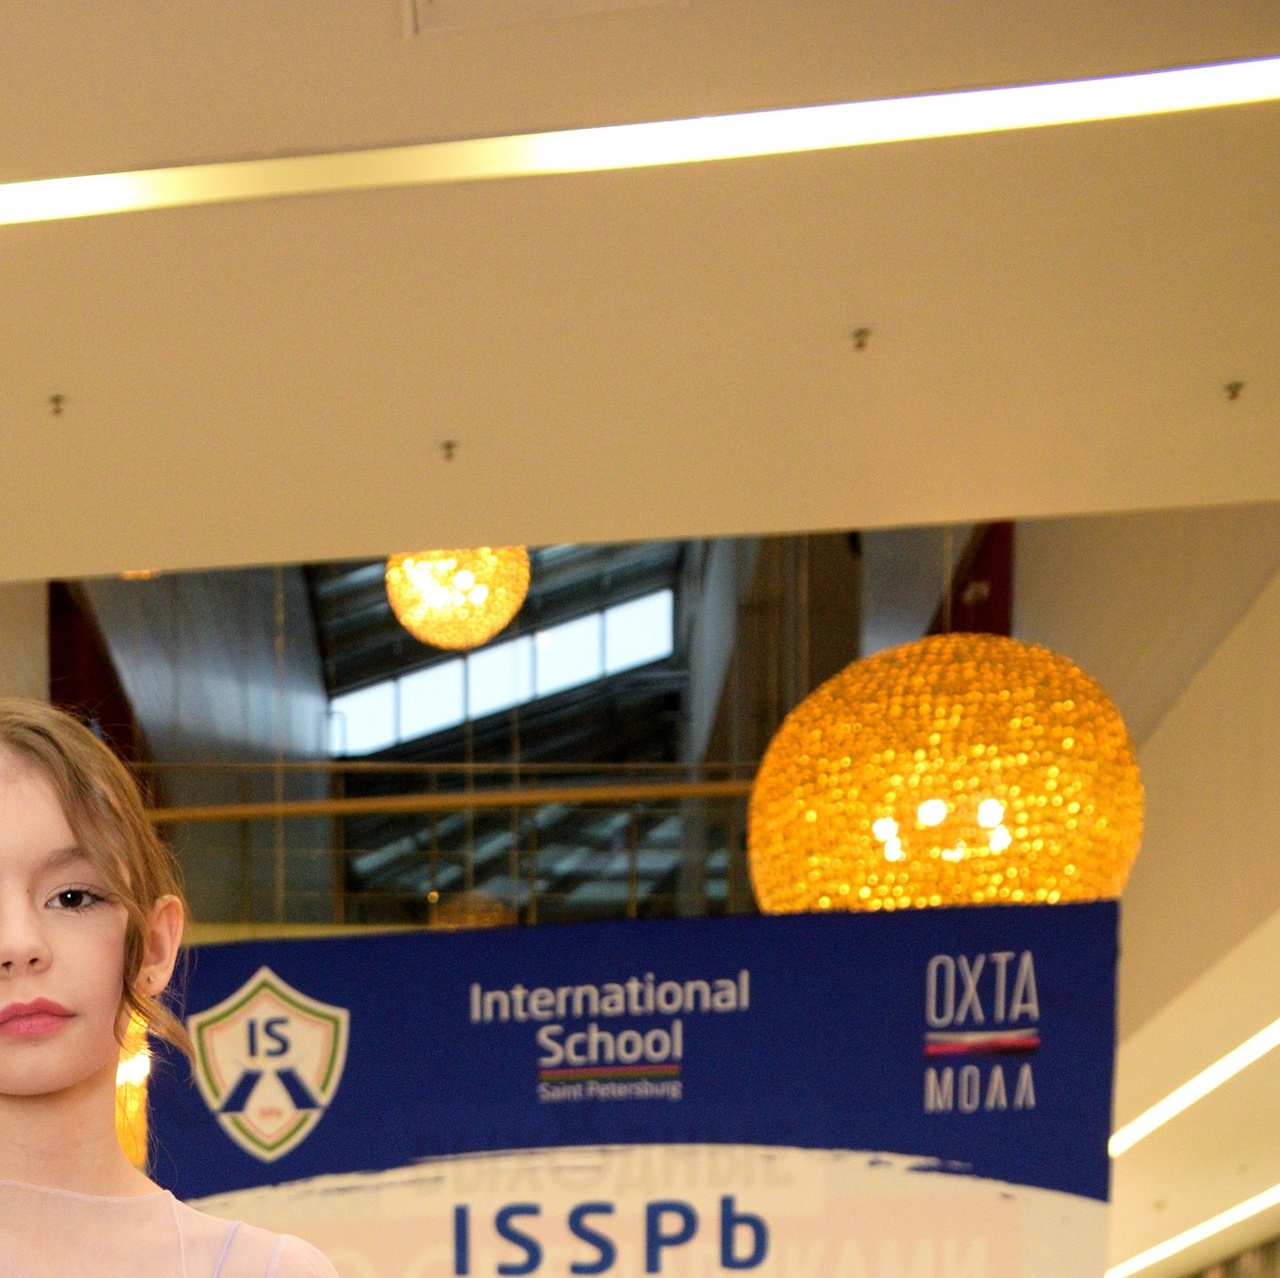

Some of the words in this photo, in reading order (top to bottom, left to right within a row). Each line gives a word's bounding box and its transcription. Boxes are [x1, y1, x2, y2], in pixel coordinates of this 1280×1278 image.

[470, 969, 750, 1023] International
[925, 950, 1039, 1028] ОХТА
[248, 1017, 289, 1057] IS
[536, 1019, 683, 1067] School
[453, 1194, 769, 1277] ISSPb
